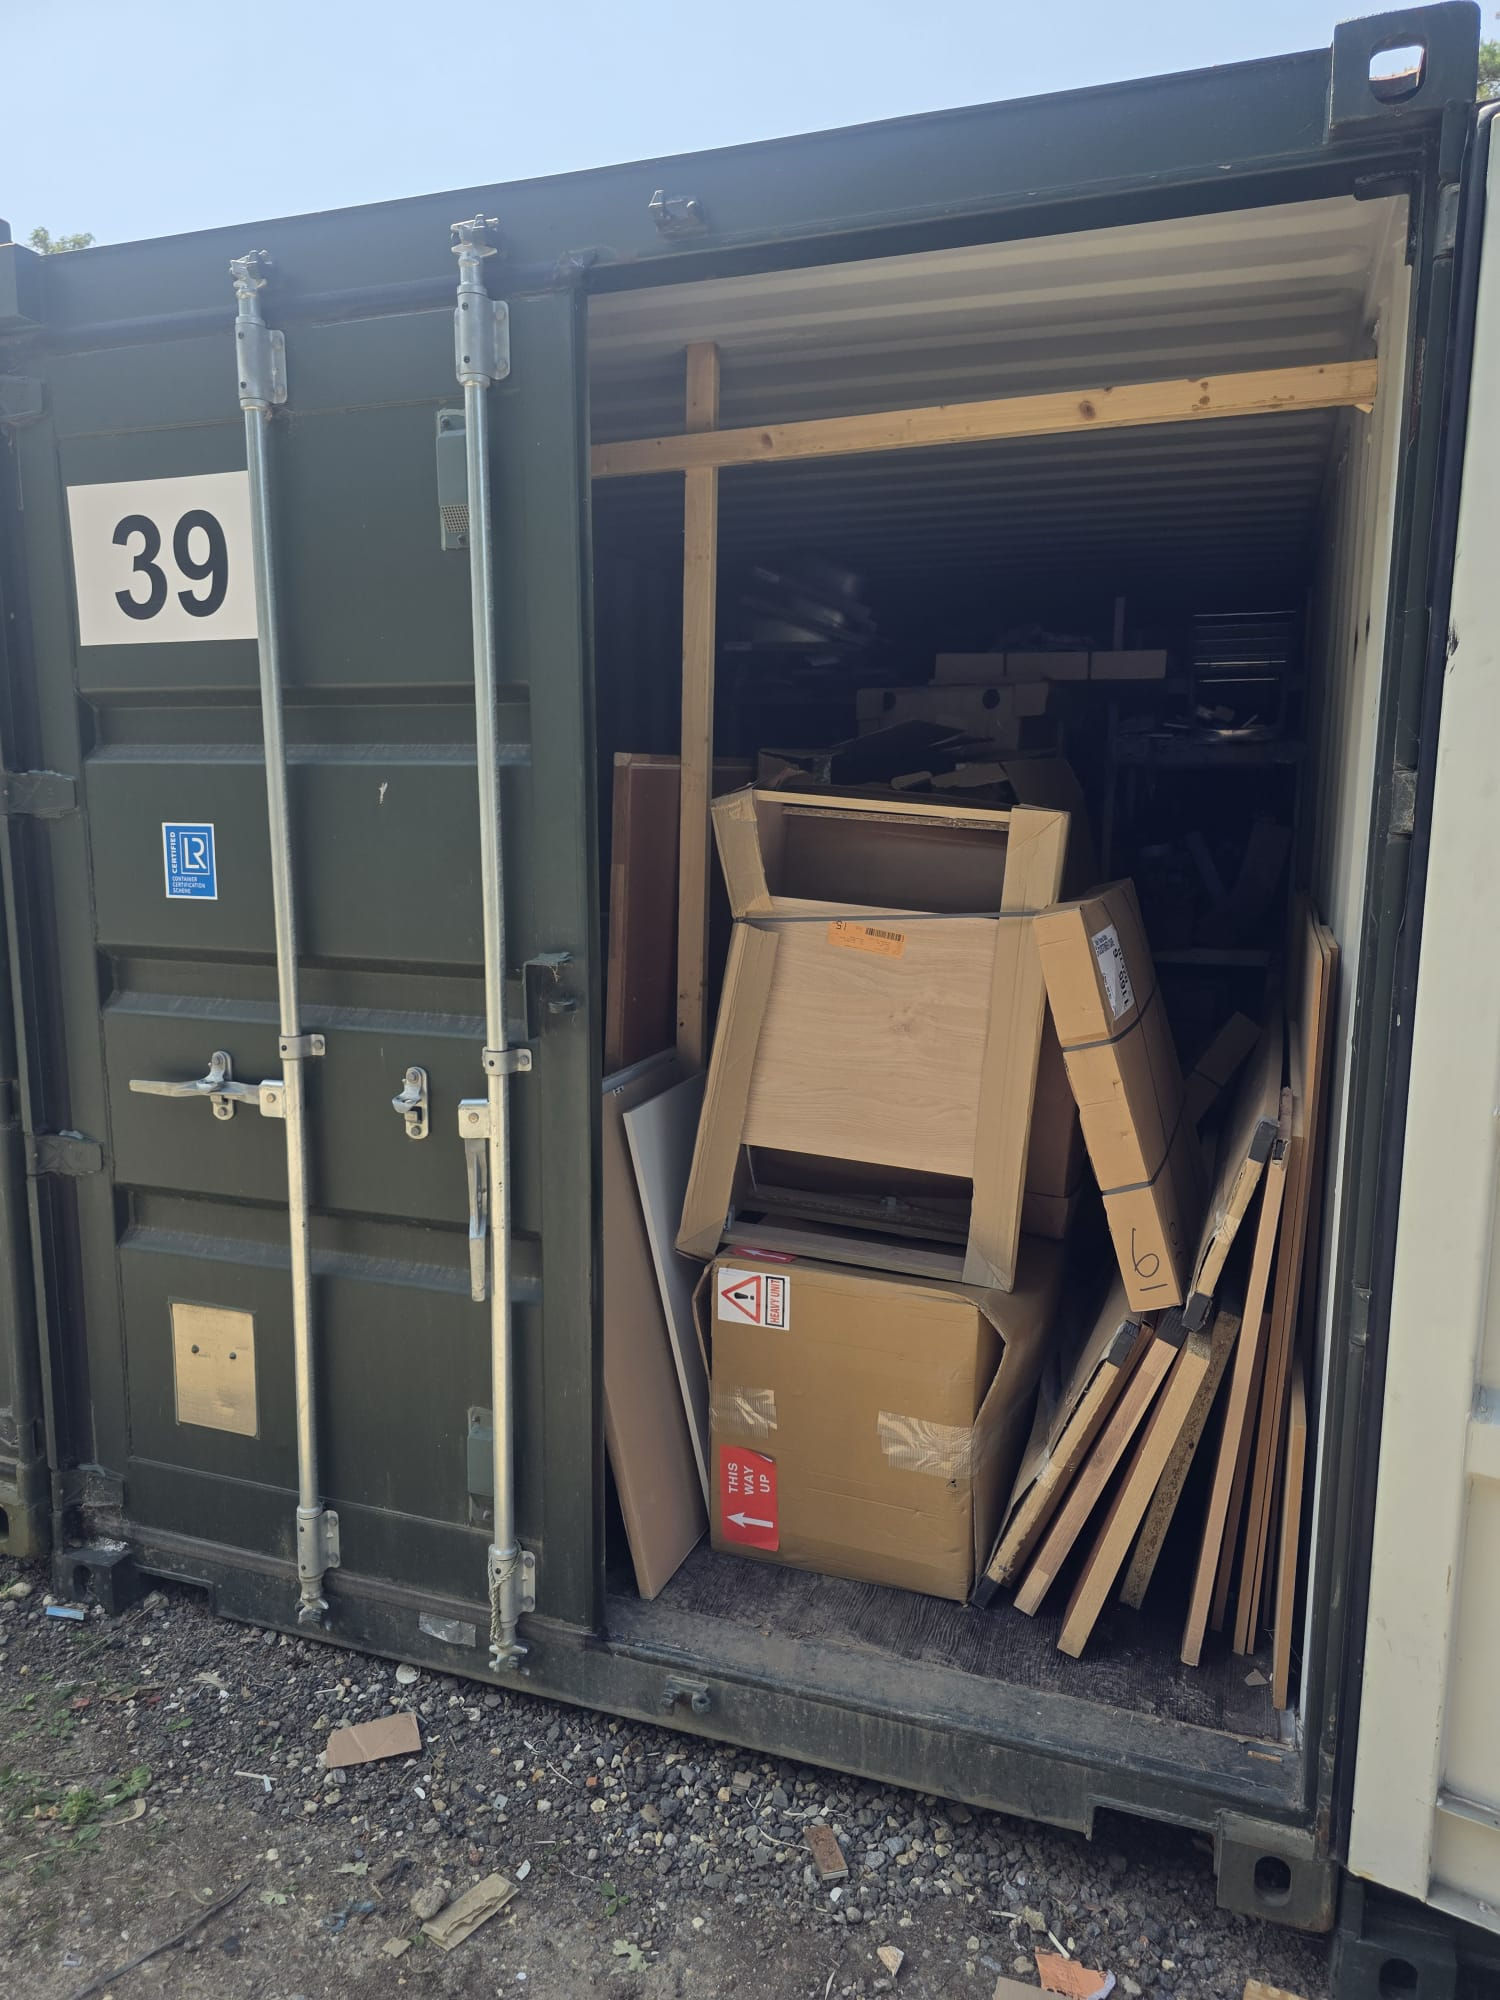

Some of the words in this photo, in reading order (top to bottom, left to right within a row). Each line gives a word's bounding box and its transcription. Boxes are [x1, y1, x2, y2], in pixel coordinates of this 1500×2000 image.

[112, 509, 229, 620] 39
[183, 837, 207, 869] LR
[770, 1279, 780, 1297] UNIT
[769, 1299, 780, 1323] HEAVY
[727, 1462, 738, 1493] THIS
[743, 1465, 754, 1496] WAY
[760, 1474, 771, 1493] UP
